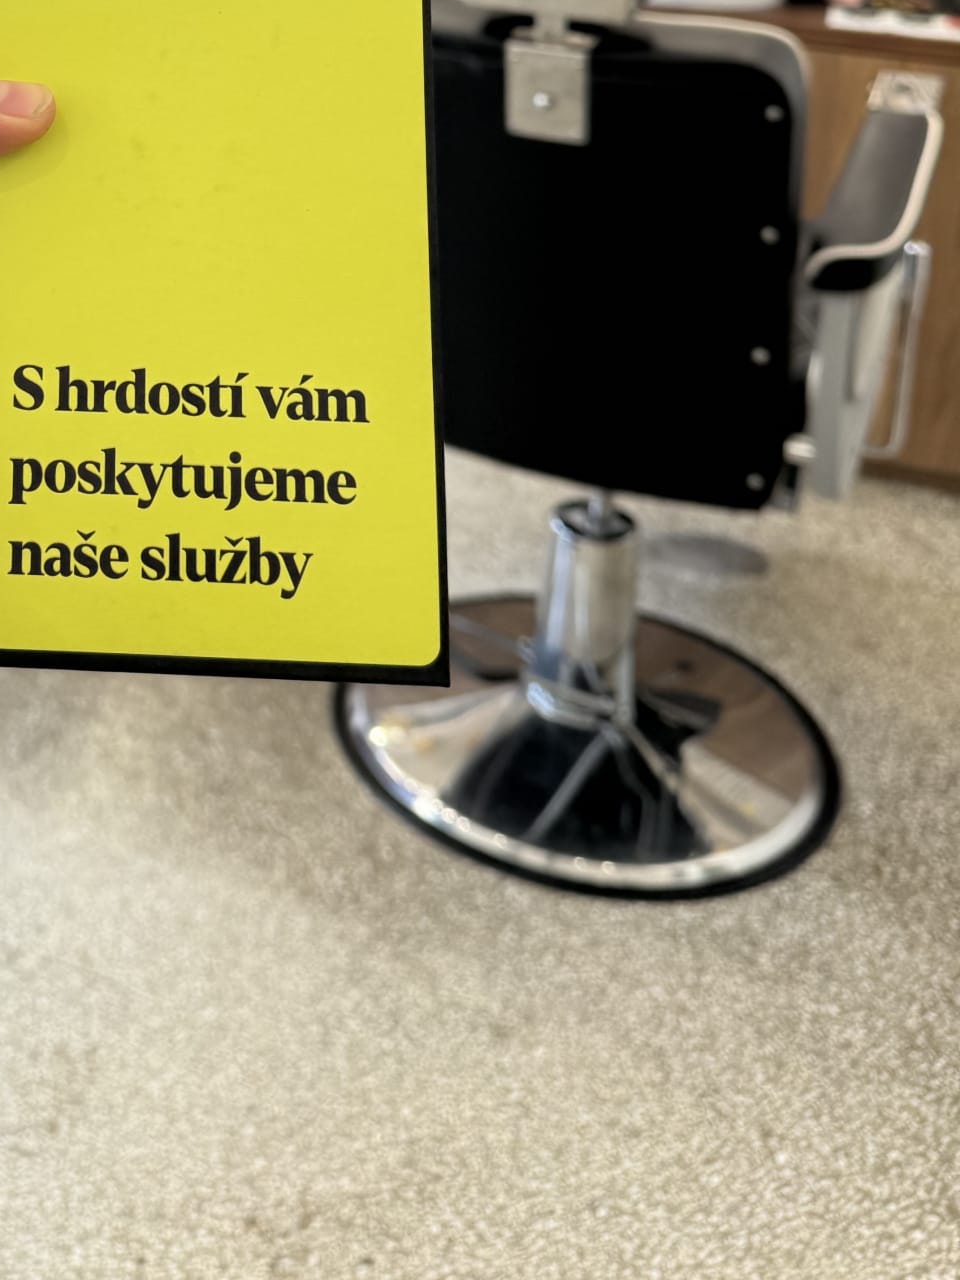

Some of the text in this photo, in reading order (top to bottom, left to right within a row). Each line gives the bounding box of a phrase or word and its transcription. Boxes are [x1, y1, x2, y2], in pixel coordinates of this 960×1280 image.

[13, 364, 370, 423] S hrdostí vám
[7, 447, 358, 511] poskytujeme
[7, 529, 314, 600] naše služby
